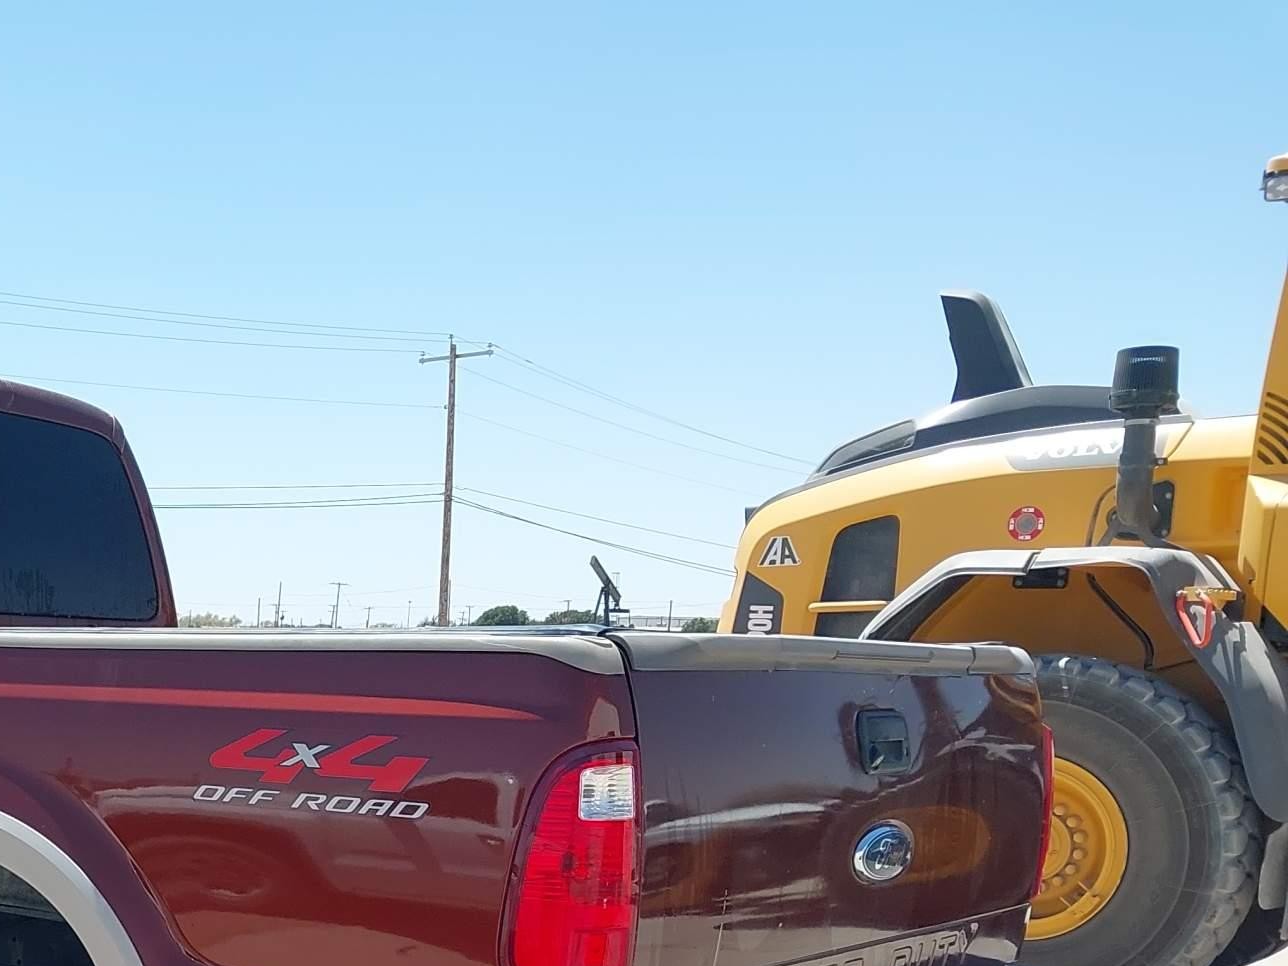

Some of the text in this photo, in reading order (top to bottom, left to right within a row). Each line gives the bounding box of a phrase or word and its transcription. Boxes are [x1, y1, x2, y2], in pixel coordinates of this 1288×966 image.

[747, 605, 774, 635] 0H
[193, 784, 431, 820] OFF ROAD
